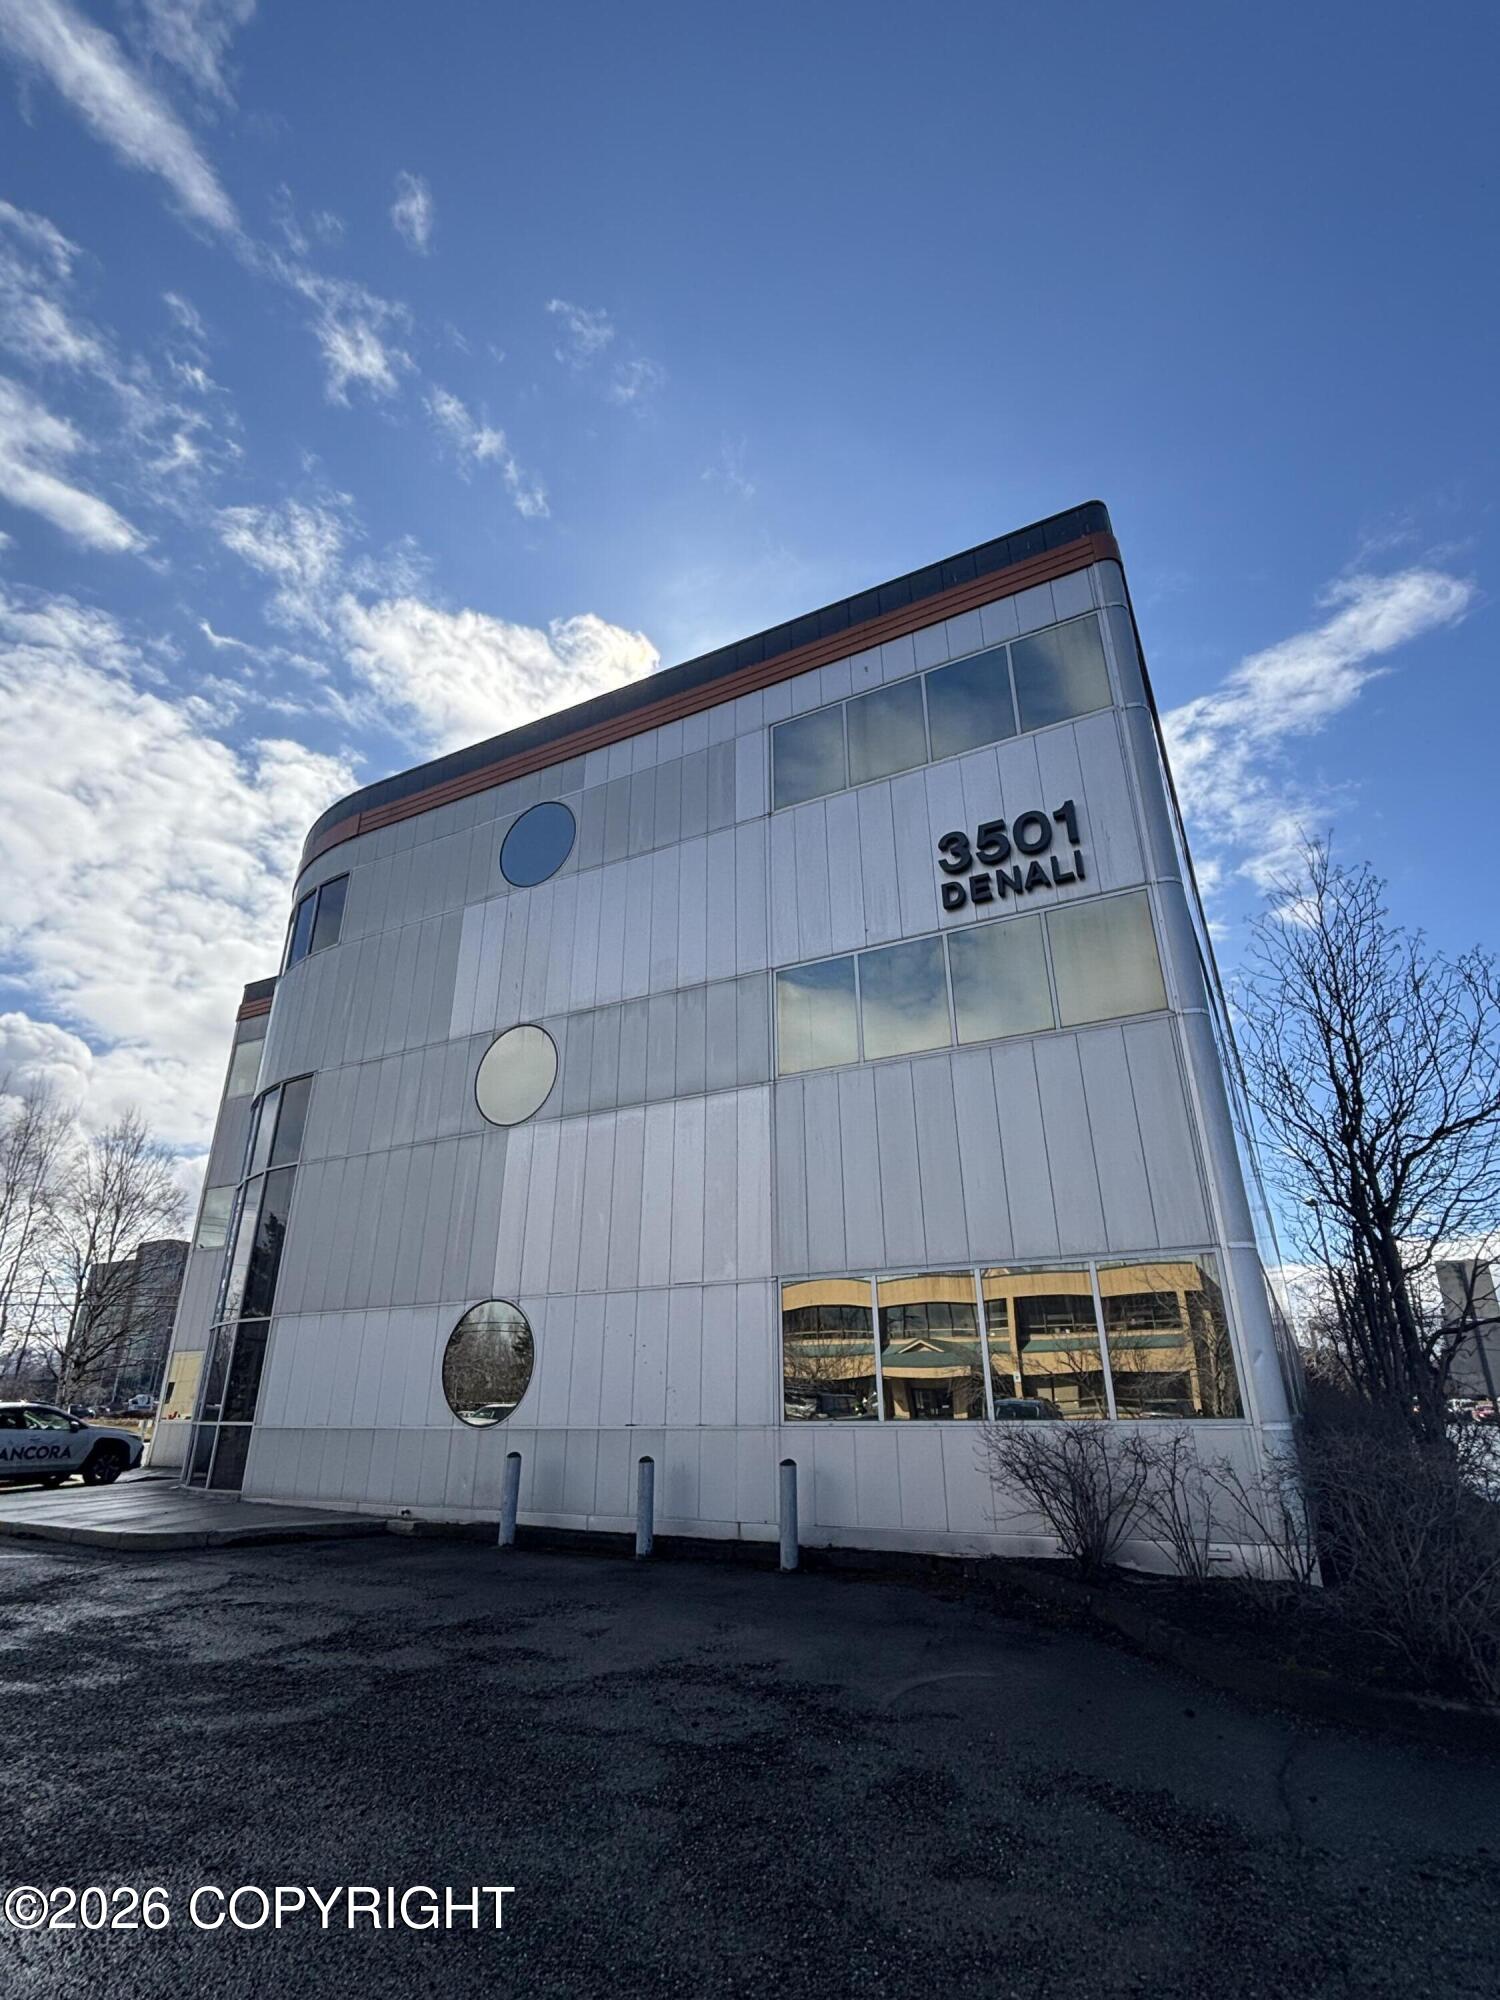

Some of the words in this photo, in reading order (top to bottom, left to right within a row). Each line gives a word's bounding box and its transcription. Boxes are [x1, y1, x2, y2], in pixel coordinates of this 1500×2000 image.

[938, 799, 1080, 876] 3501
[941, 849, 1085, 912] DENALI
[0, 1445, 71, 1461] ANCORA
